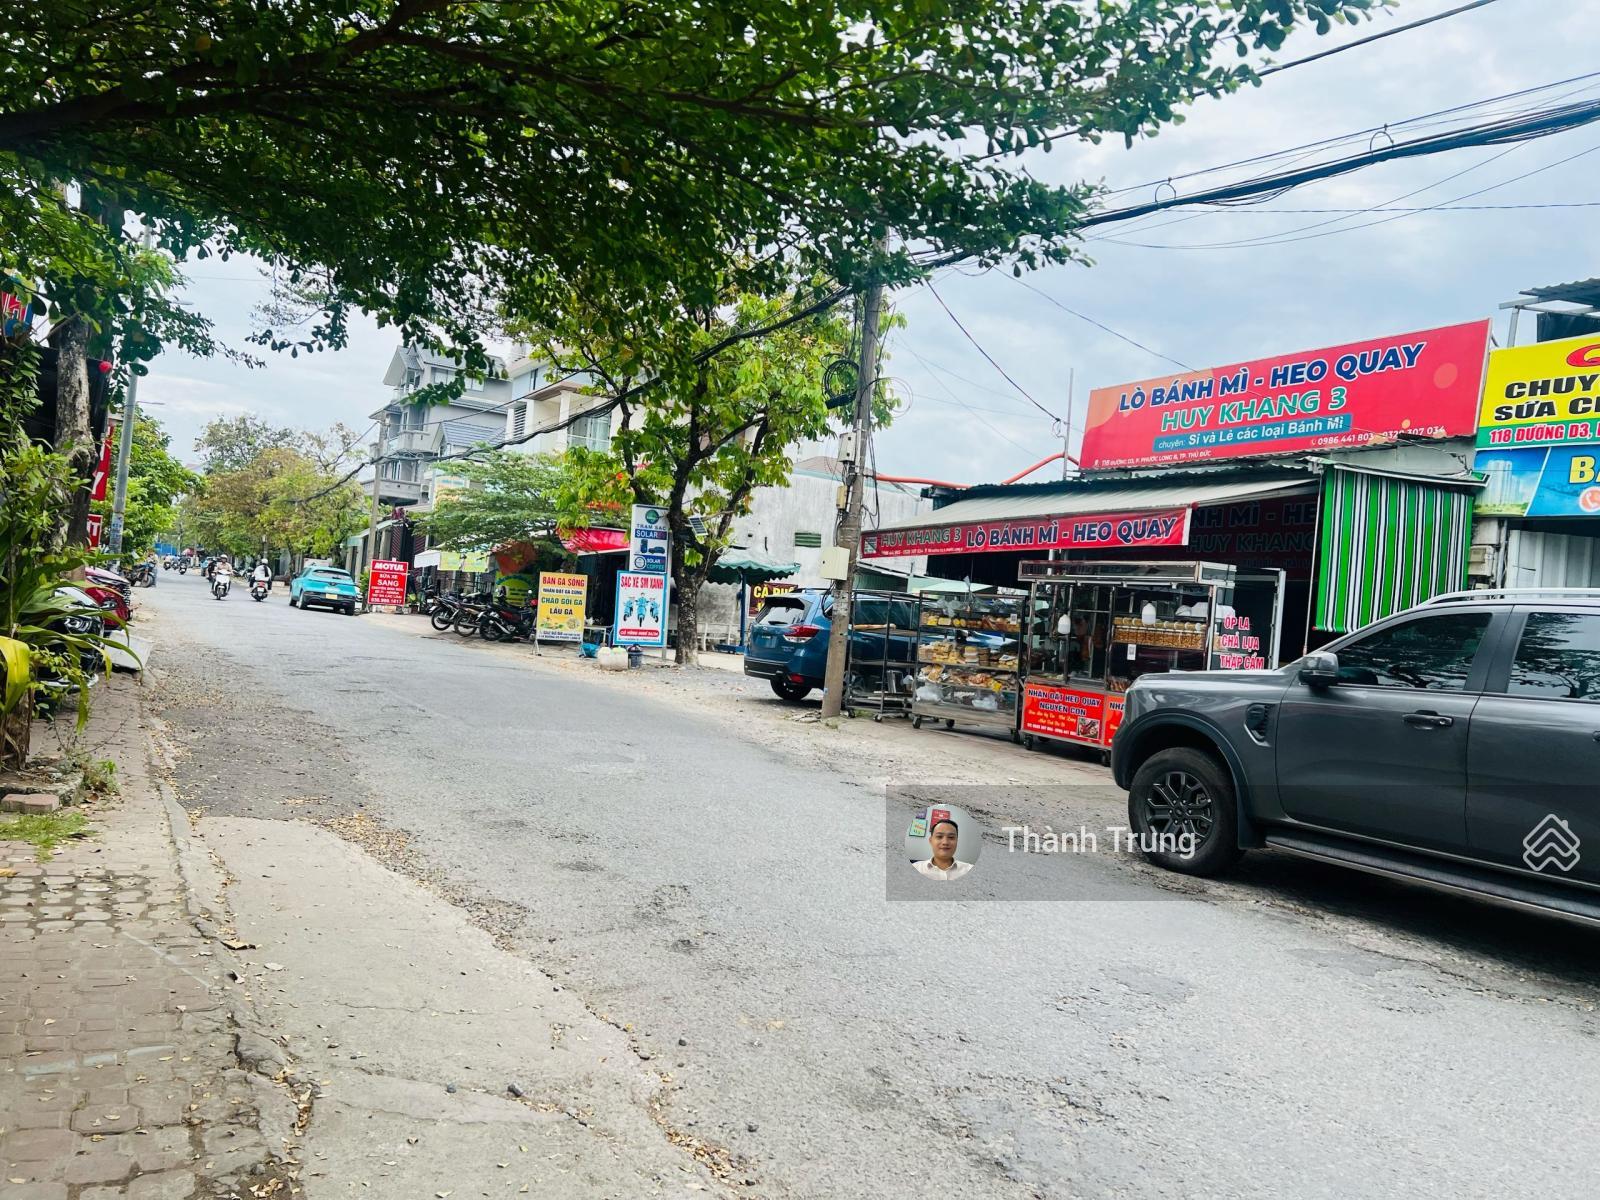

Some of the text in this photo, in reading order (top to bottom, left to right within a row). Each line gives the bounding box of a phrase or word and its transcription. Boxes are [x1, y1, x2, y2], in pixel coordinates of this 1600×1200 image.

[1119, 341, 1427, 411] LÒ BÁNH MÌ - HEO QUAY
[1505, 373, 1599, 399] CHUY
[1161, 386, 1346, 432] HUY KHANG 3
[1202, 431, 1215, 444] và
[1236, 426, 1257, 440] các
[1261, 423, 1284, 440] loại
[1288, 419, 1322, 435] Bánh
[1326, 415, 1344, 430] Mì
[1490, 428, 1511, 445] 118
[1568, 423, 1593, 440] D3,
[1318, 435, 1339, 446] 0986
[1340, 434, 1356, 443] 441
[1192, 507, 1224, 529] NH
[1282, 502, 1316, 526] HE
[636, 530, 658, 539] SOLAR
[880, 532, 906, 548] HUY
[906, 528, 951, 546] KHANG
[954, 527, 962, 543] 3
[966, 527, 986, 549] LÒ
[989, 523, 1034, 546] BÁNH
[1038, 519, 1058, 544] MÌ
[1073, 521, 1112, 543] HEO
[1116, 517, 1178, 545] QUAY
[374, 562, 405, 571] MOTUL
[377, 579, 399, 587] SANG
[632, 576, 640, 588] XE
[640, 577, 650, 589] SM
[650, 578, 664, 590] XANH
[1238, 616, 1250, 630] LA
[1039, 701, 1068, 714] NGUYÊN
[1069, 707, 1087, 716] CON
[1065, 695, 1080, 703] HEO
[1081, 697, 1102, 707] QUAY
